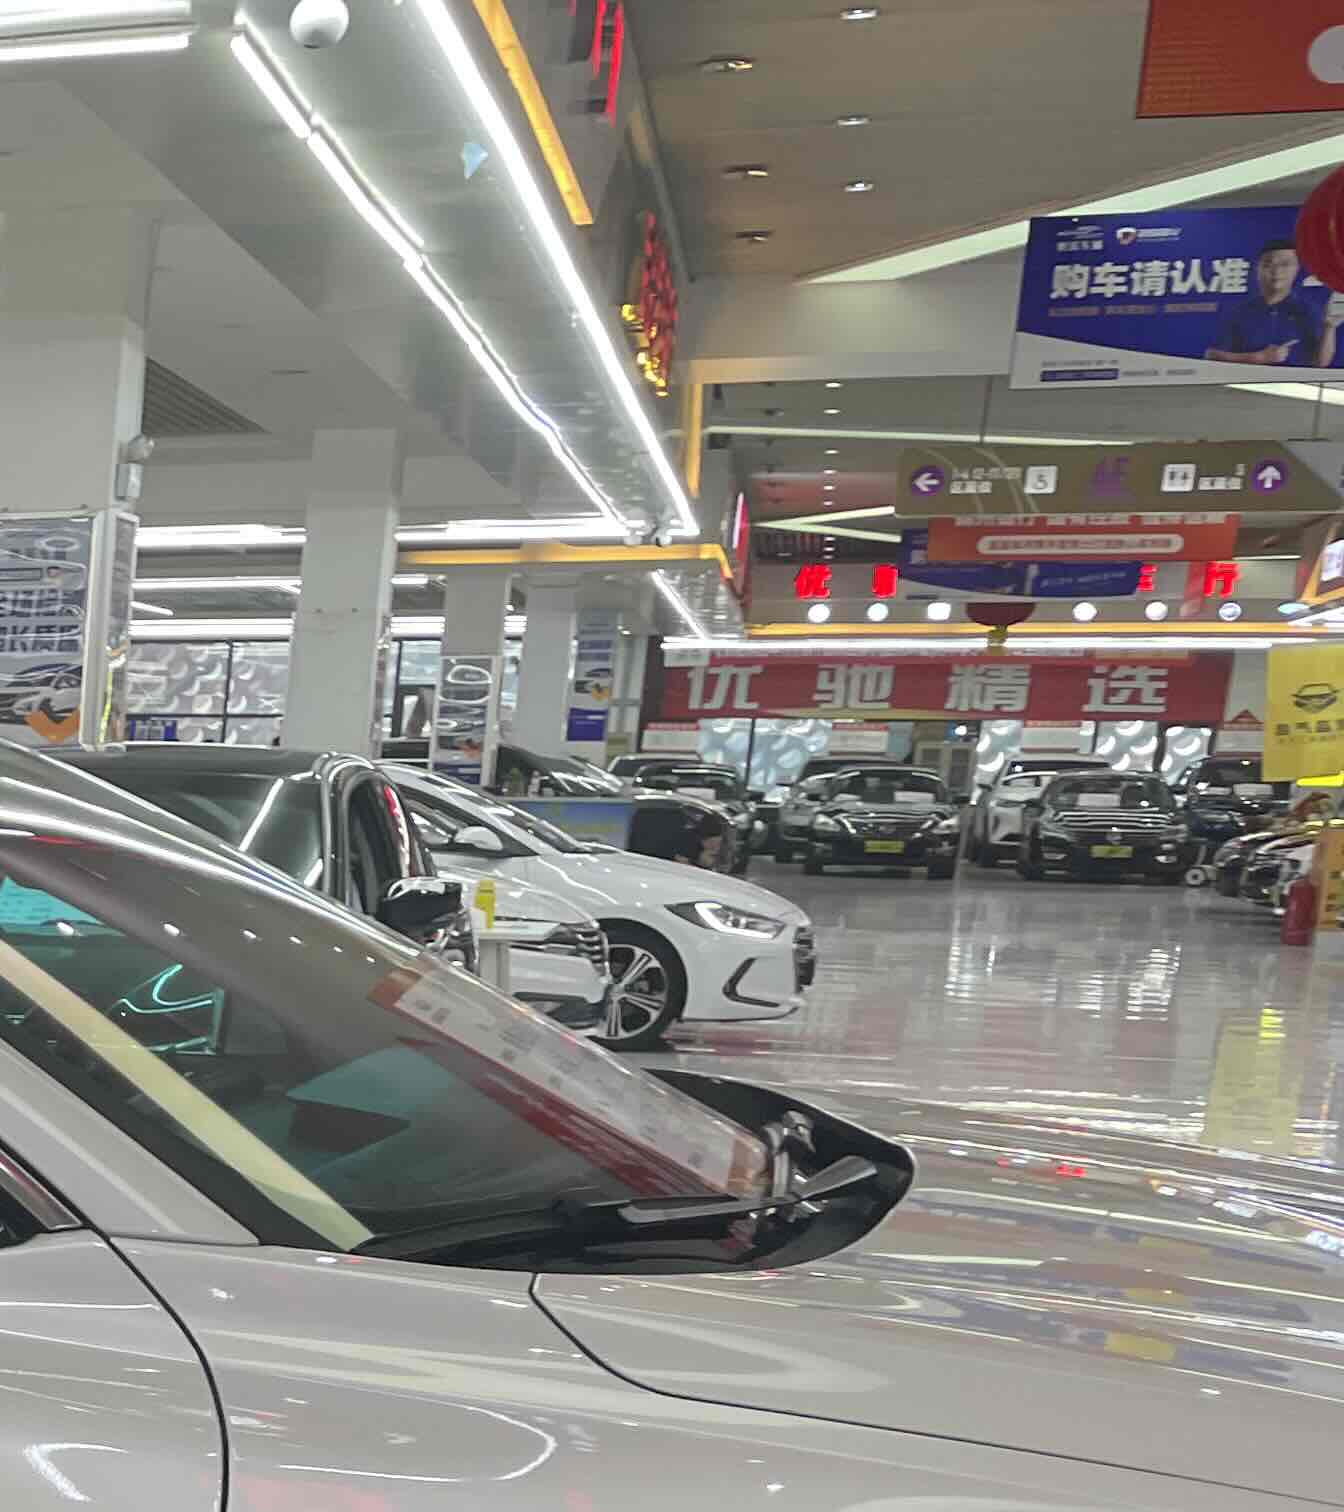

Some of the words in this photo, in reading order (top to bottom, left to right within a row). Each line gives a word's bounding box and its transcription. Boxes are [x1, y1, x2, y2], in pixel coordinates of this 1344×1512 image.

[1049, 257, 1250, 300] 购车请认准
[686, 664, 1170, 714] 优驰精选
